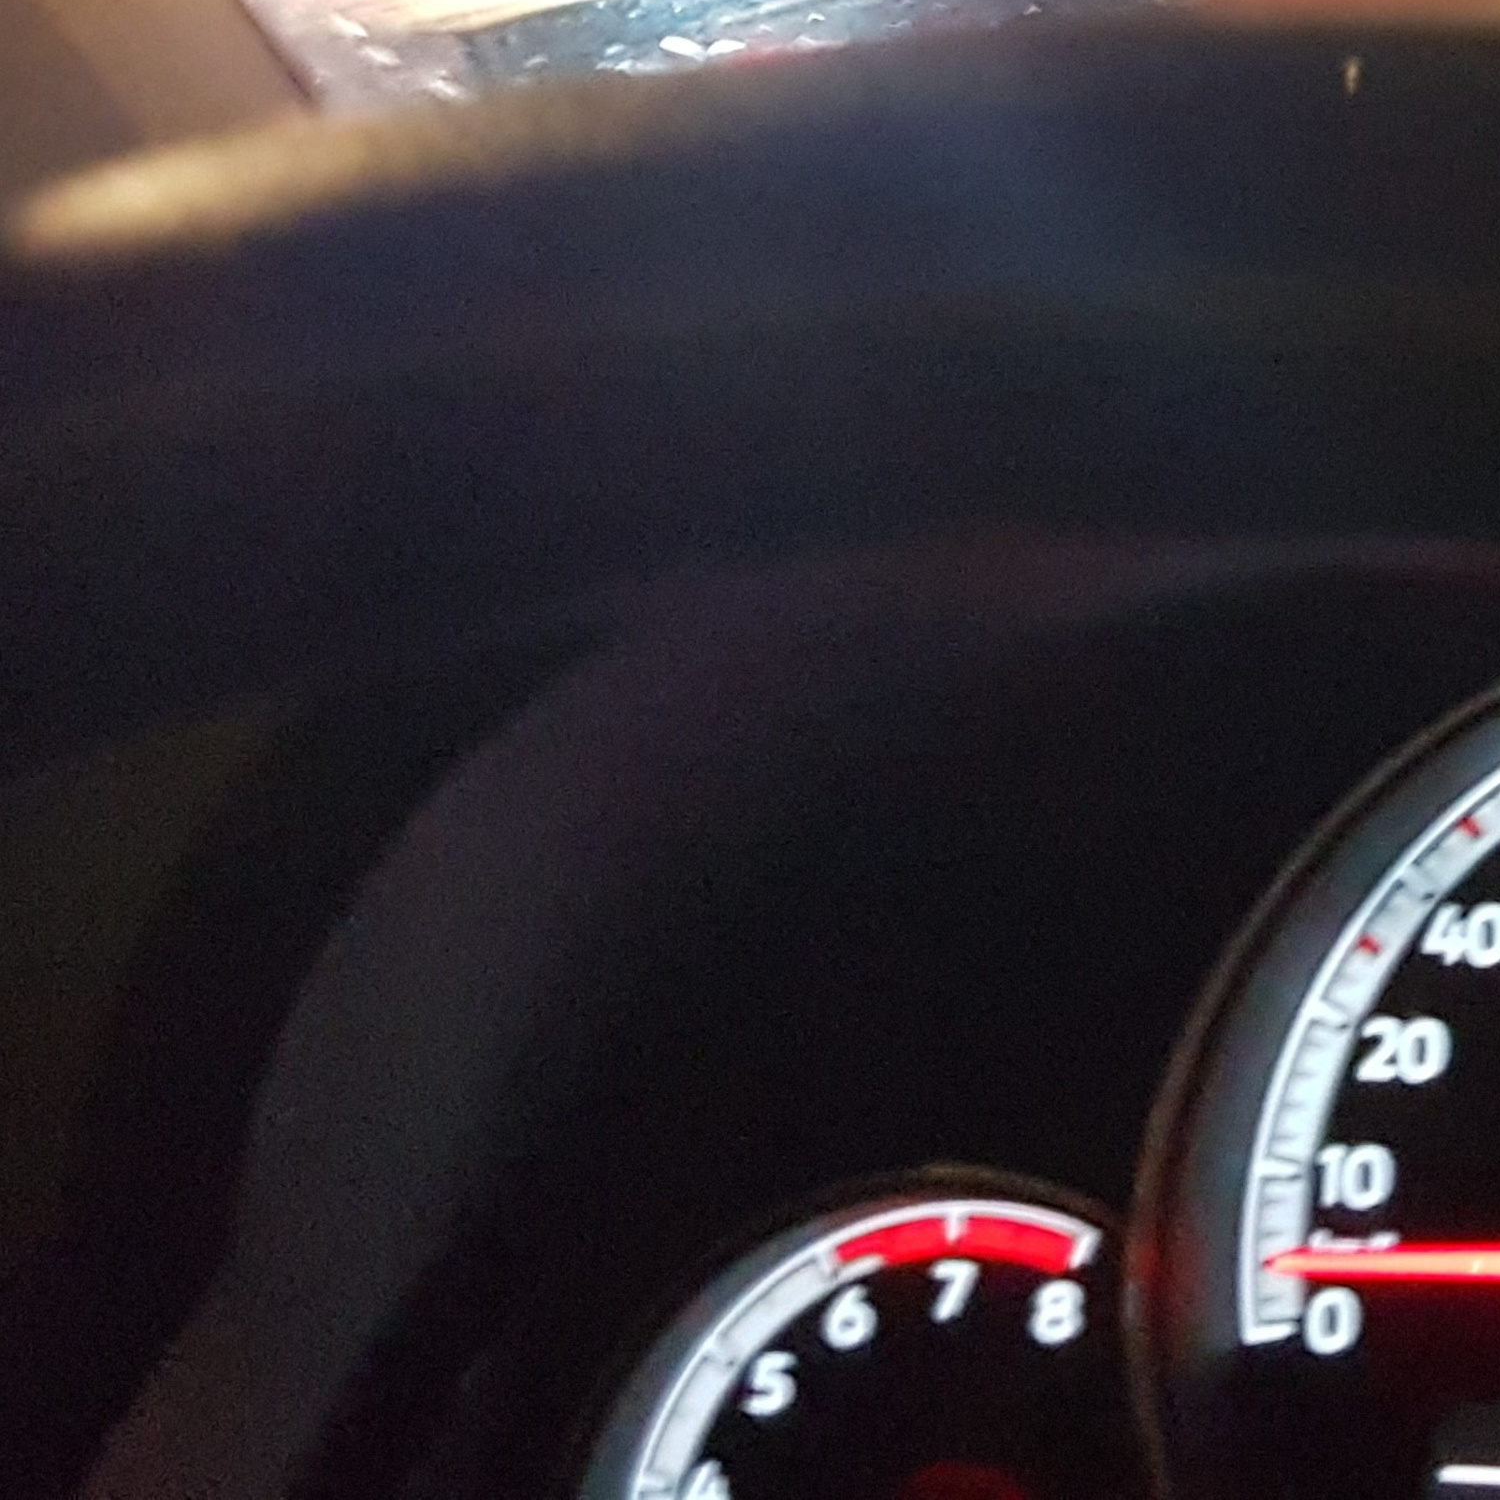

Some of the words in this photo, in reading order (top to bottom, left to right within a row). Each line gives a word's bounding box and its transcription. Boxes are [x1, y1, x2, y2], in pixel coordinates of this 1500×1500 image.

[1355, 1018, 1450, 1085] 20
[1317, 1143, 1396, 1211] 10
[821, 1284, 878, 1350] 6
[931, 1258, 979, 1322] 7
[1029, 1279, 1085, 1346] 8
[1303, 1286, 1362, 1356] 0
[740, 1352, 796, 1416] 5
